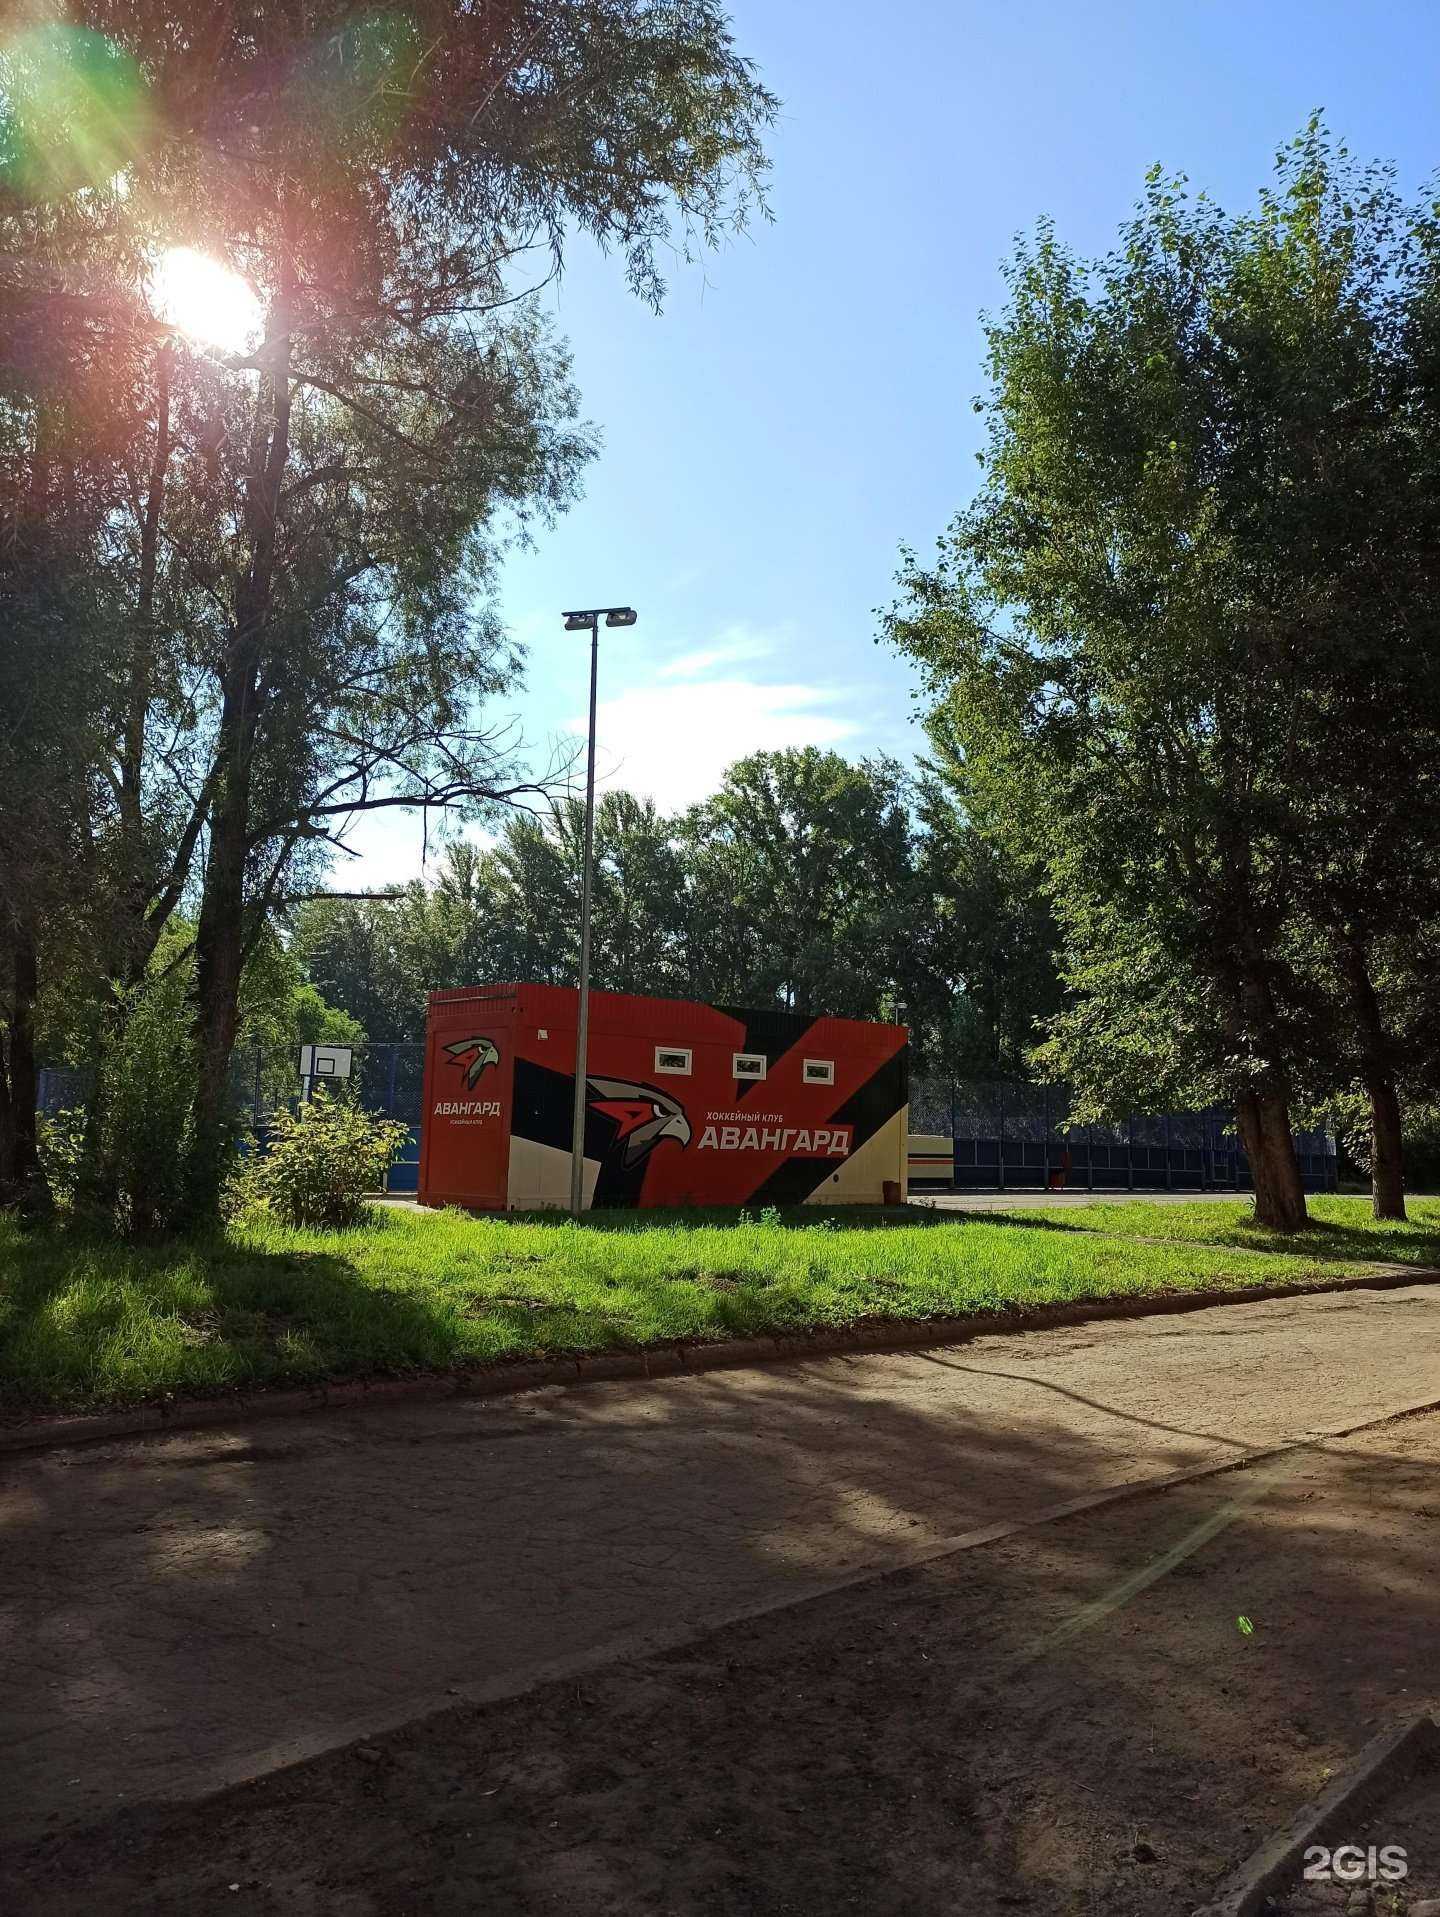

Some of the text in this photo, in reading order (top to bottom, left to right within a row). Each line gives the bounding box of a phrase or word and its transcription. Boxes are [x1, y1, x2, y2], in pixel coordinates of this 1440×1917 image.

[434, 1102, 501, 1117] АВАНГАРД
[706, 1110, 784, 1123] ХОККЕЙНЫЙ КЛУБ
[697, 1126, 849, 1155] АВАНГАРД
